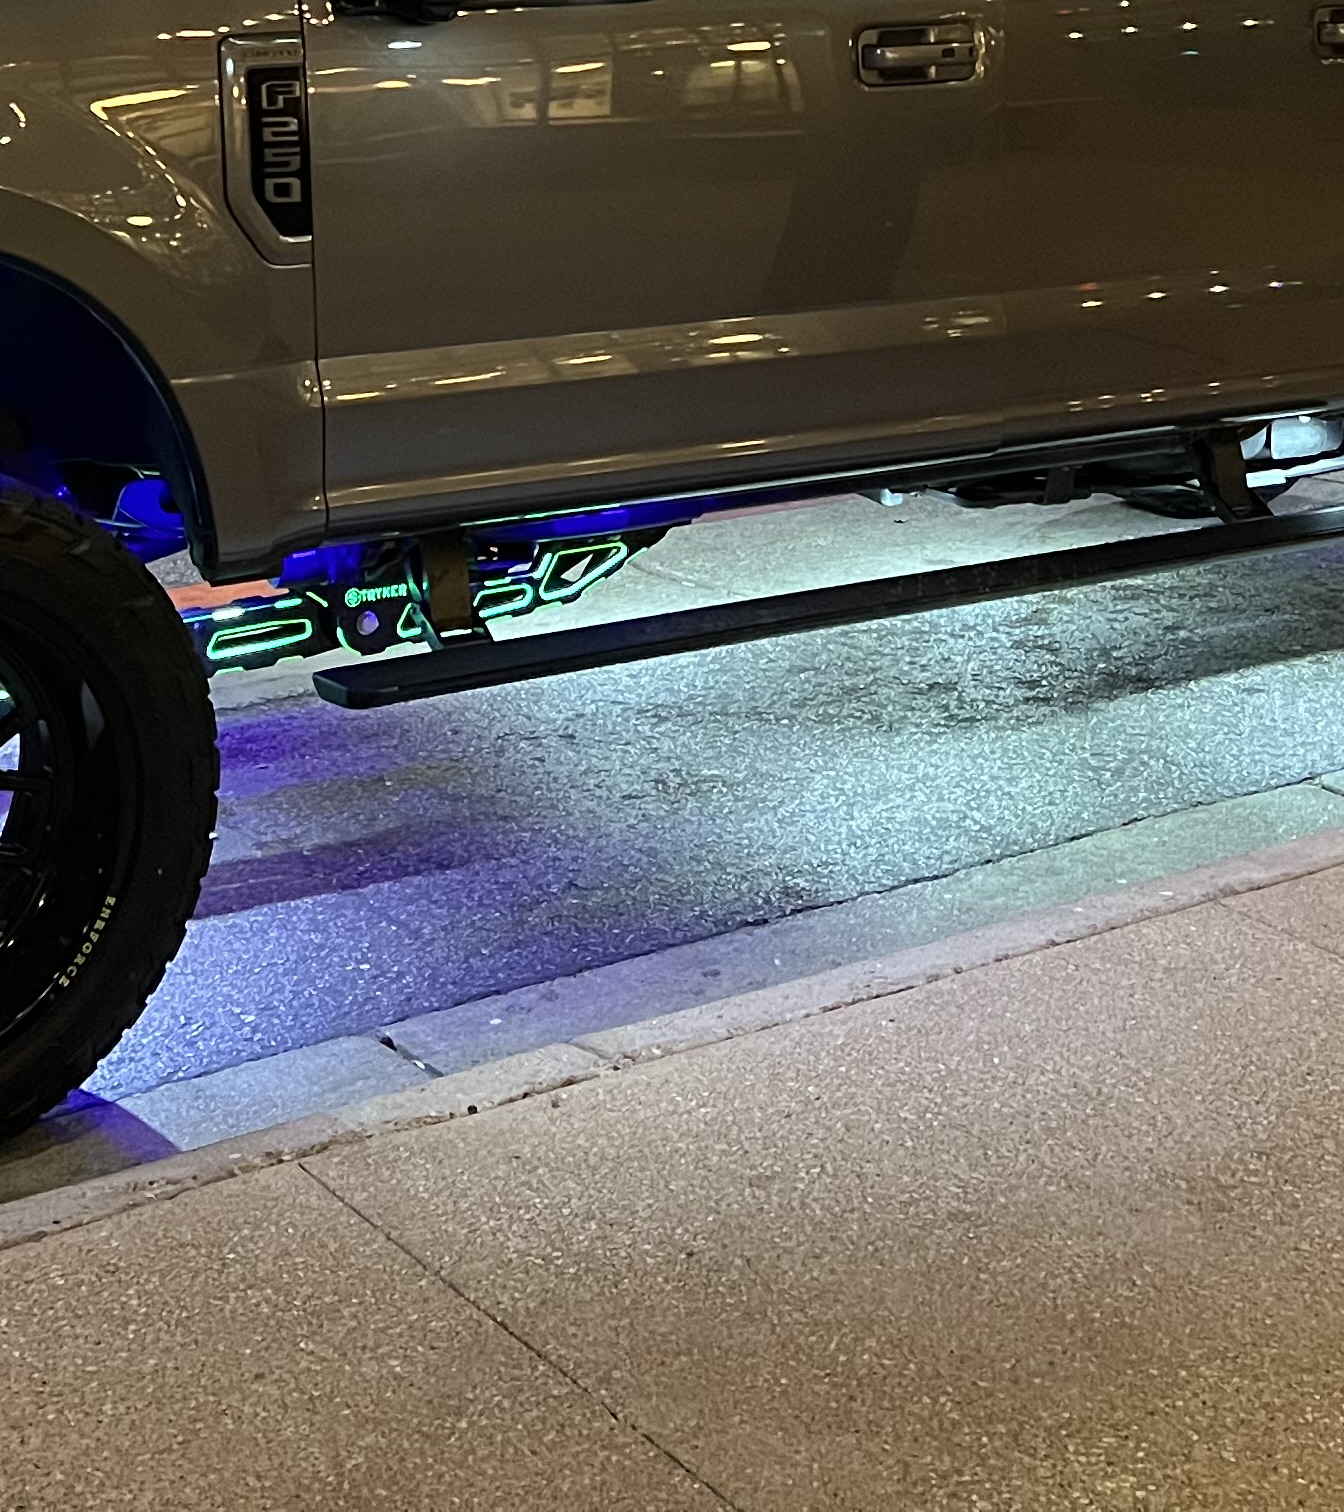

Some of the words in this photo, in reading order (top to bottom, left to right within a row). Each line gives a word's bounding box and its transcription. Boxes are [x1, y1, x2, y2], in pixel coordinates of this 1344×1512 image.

[260, 80, 303, 204] F250
[344, 583, 408, 608] STRYKER
[58, 895, 117, 988] ENRFORCE
